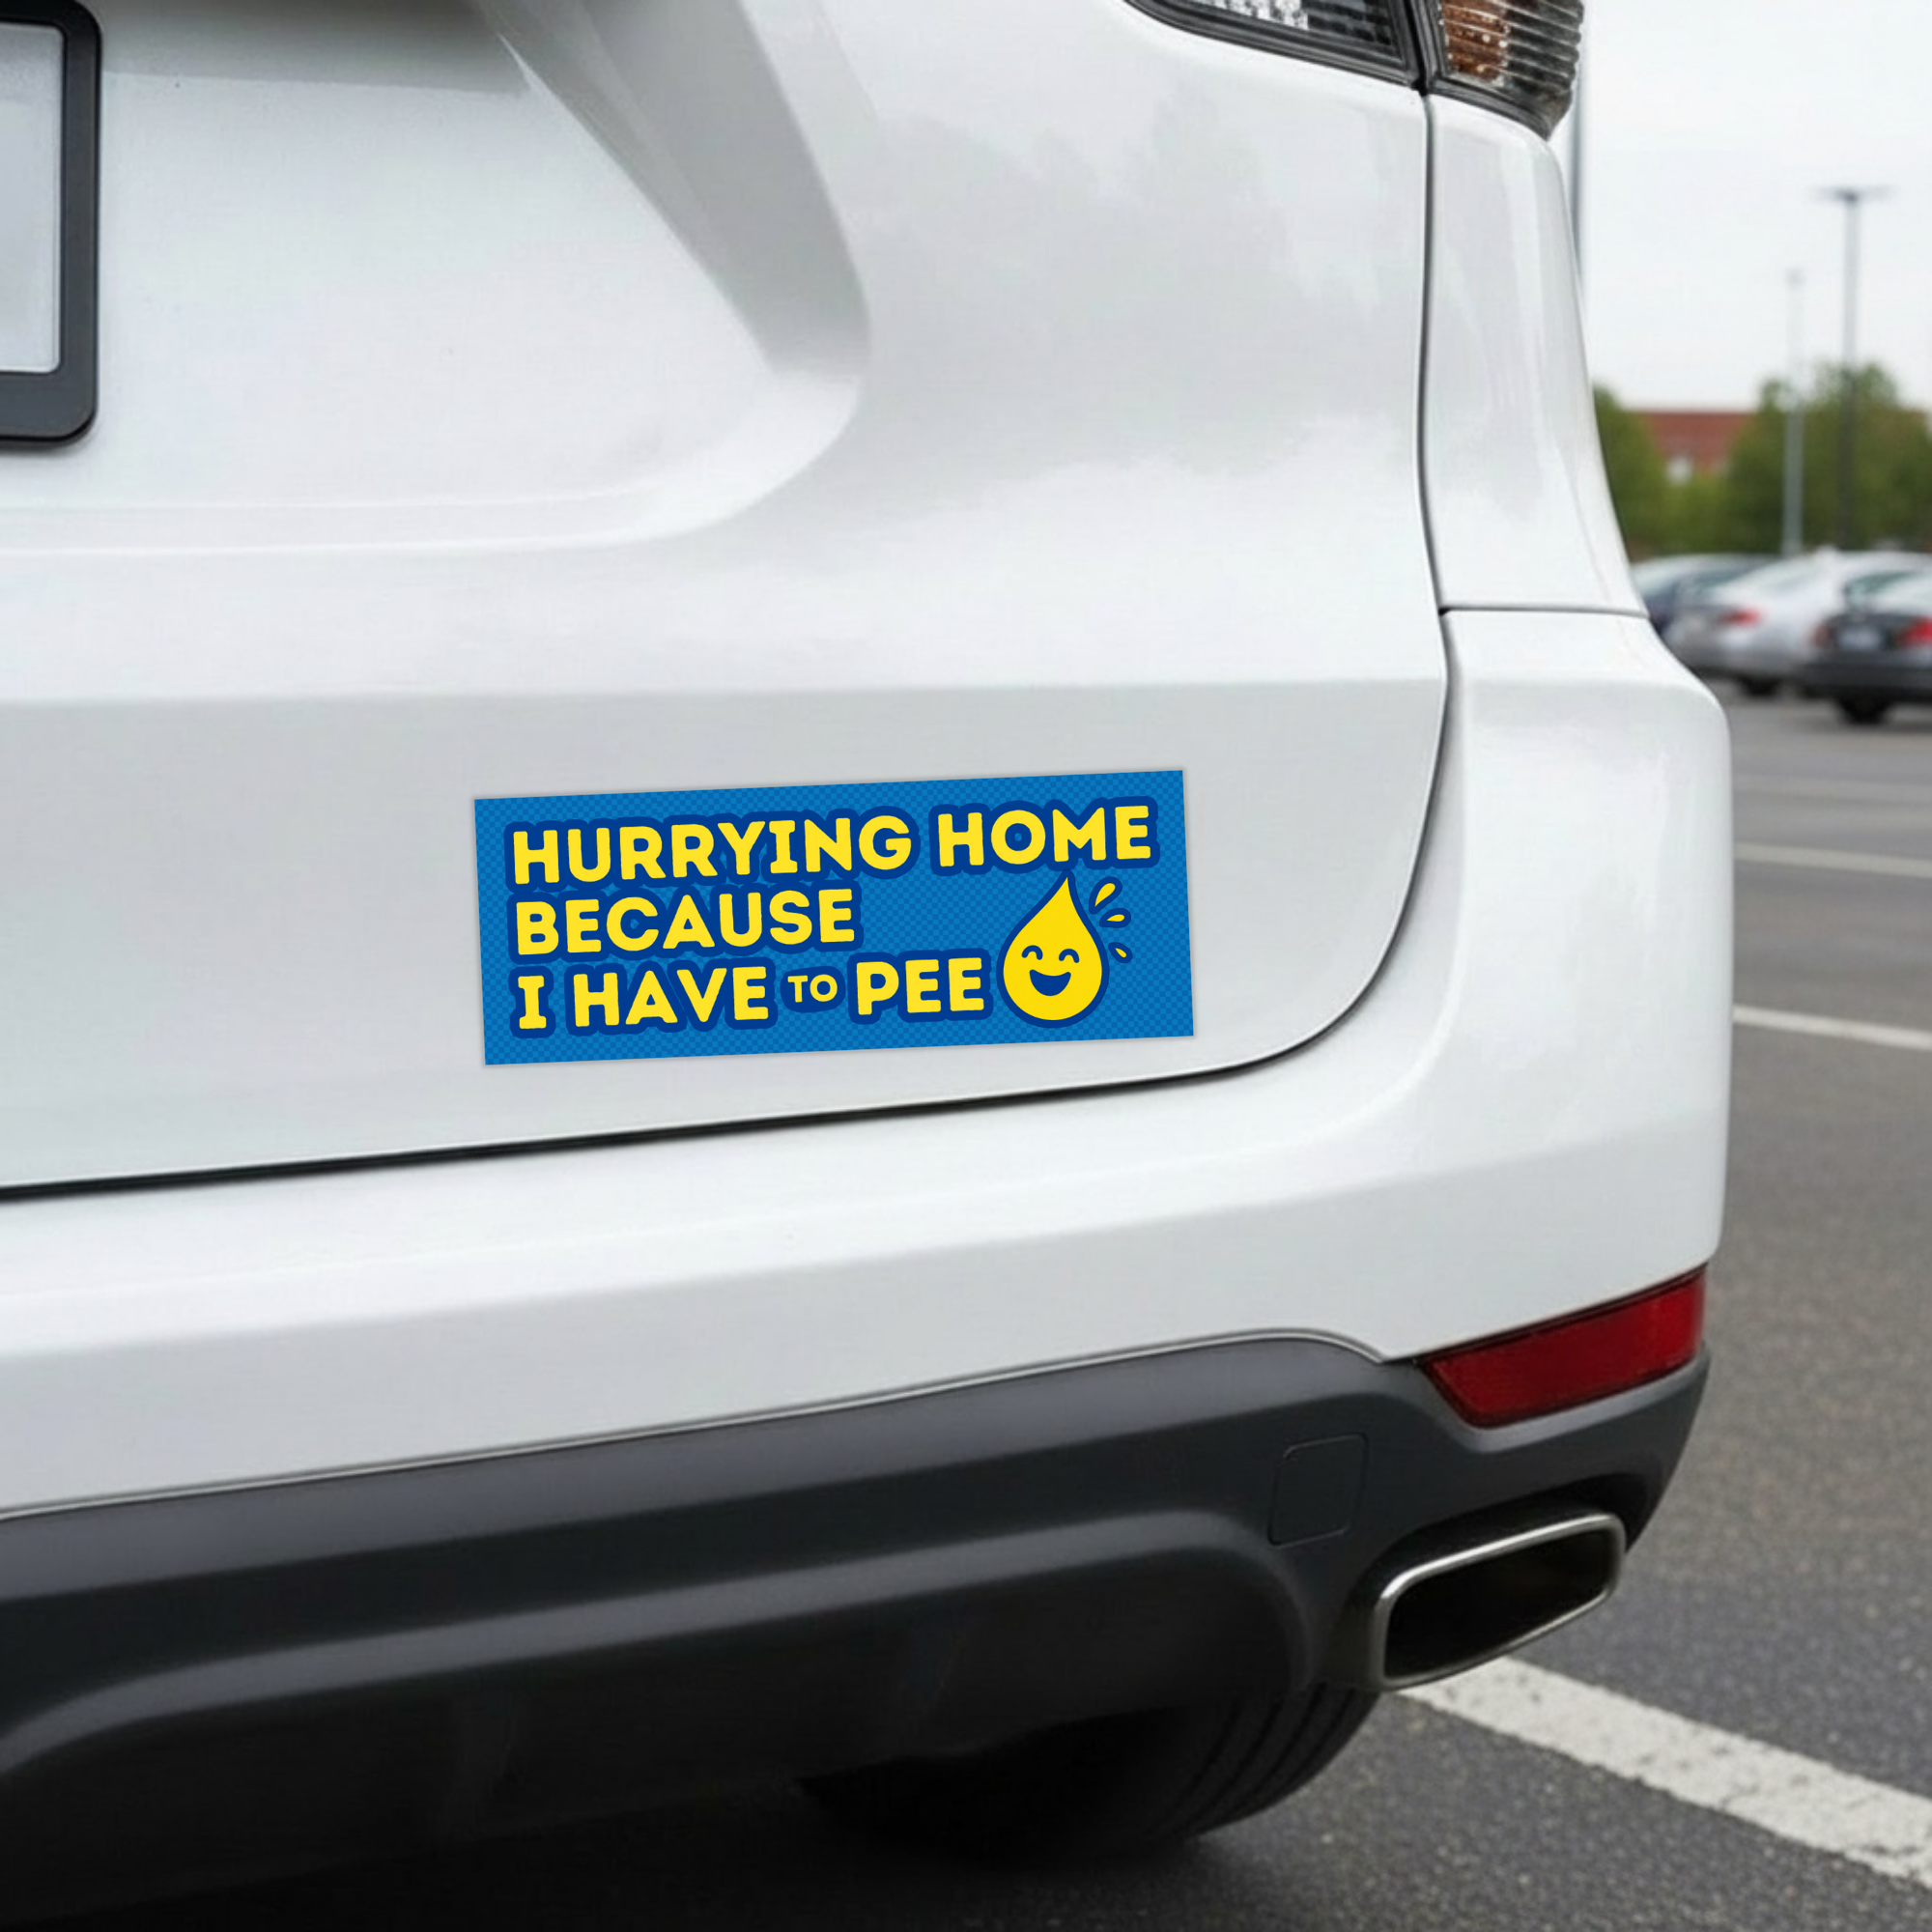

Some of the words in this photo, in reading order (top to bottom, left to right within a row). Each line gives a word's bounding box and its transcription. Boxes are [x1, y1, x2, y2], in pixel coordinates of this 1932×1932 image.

[513, 815, 912, 885] HURRYING
[937, 805, 1152, 868] HOME
[516, 888, 855, 955] BECAUSE
[517, 975, 547, 1030] I
[573, 966, 769, 1028] HAVE
[787, 974, 838, 1003] TO
[856, 956, 984, 1015] PEE
